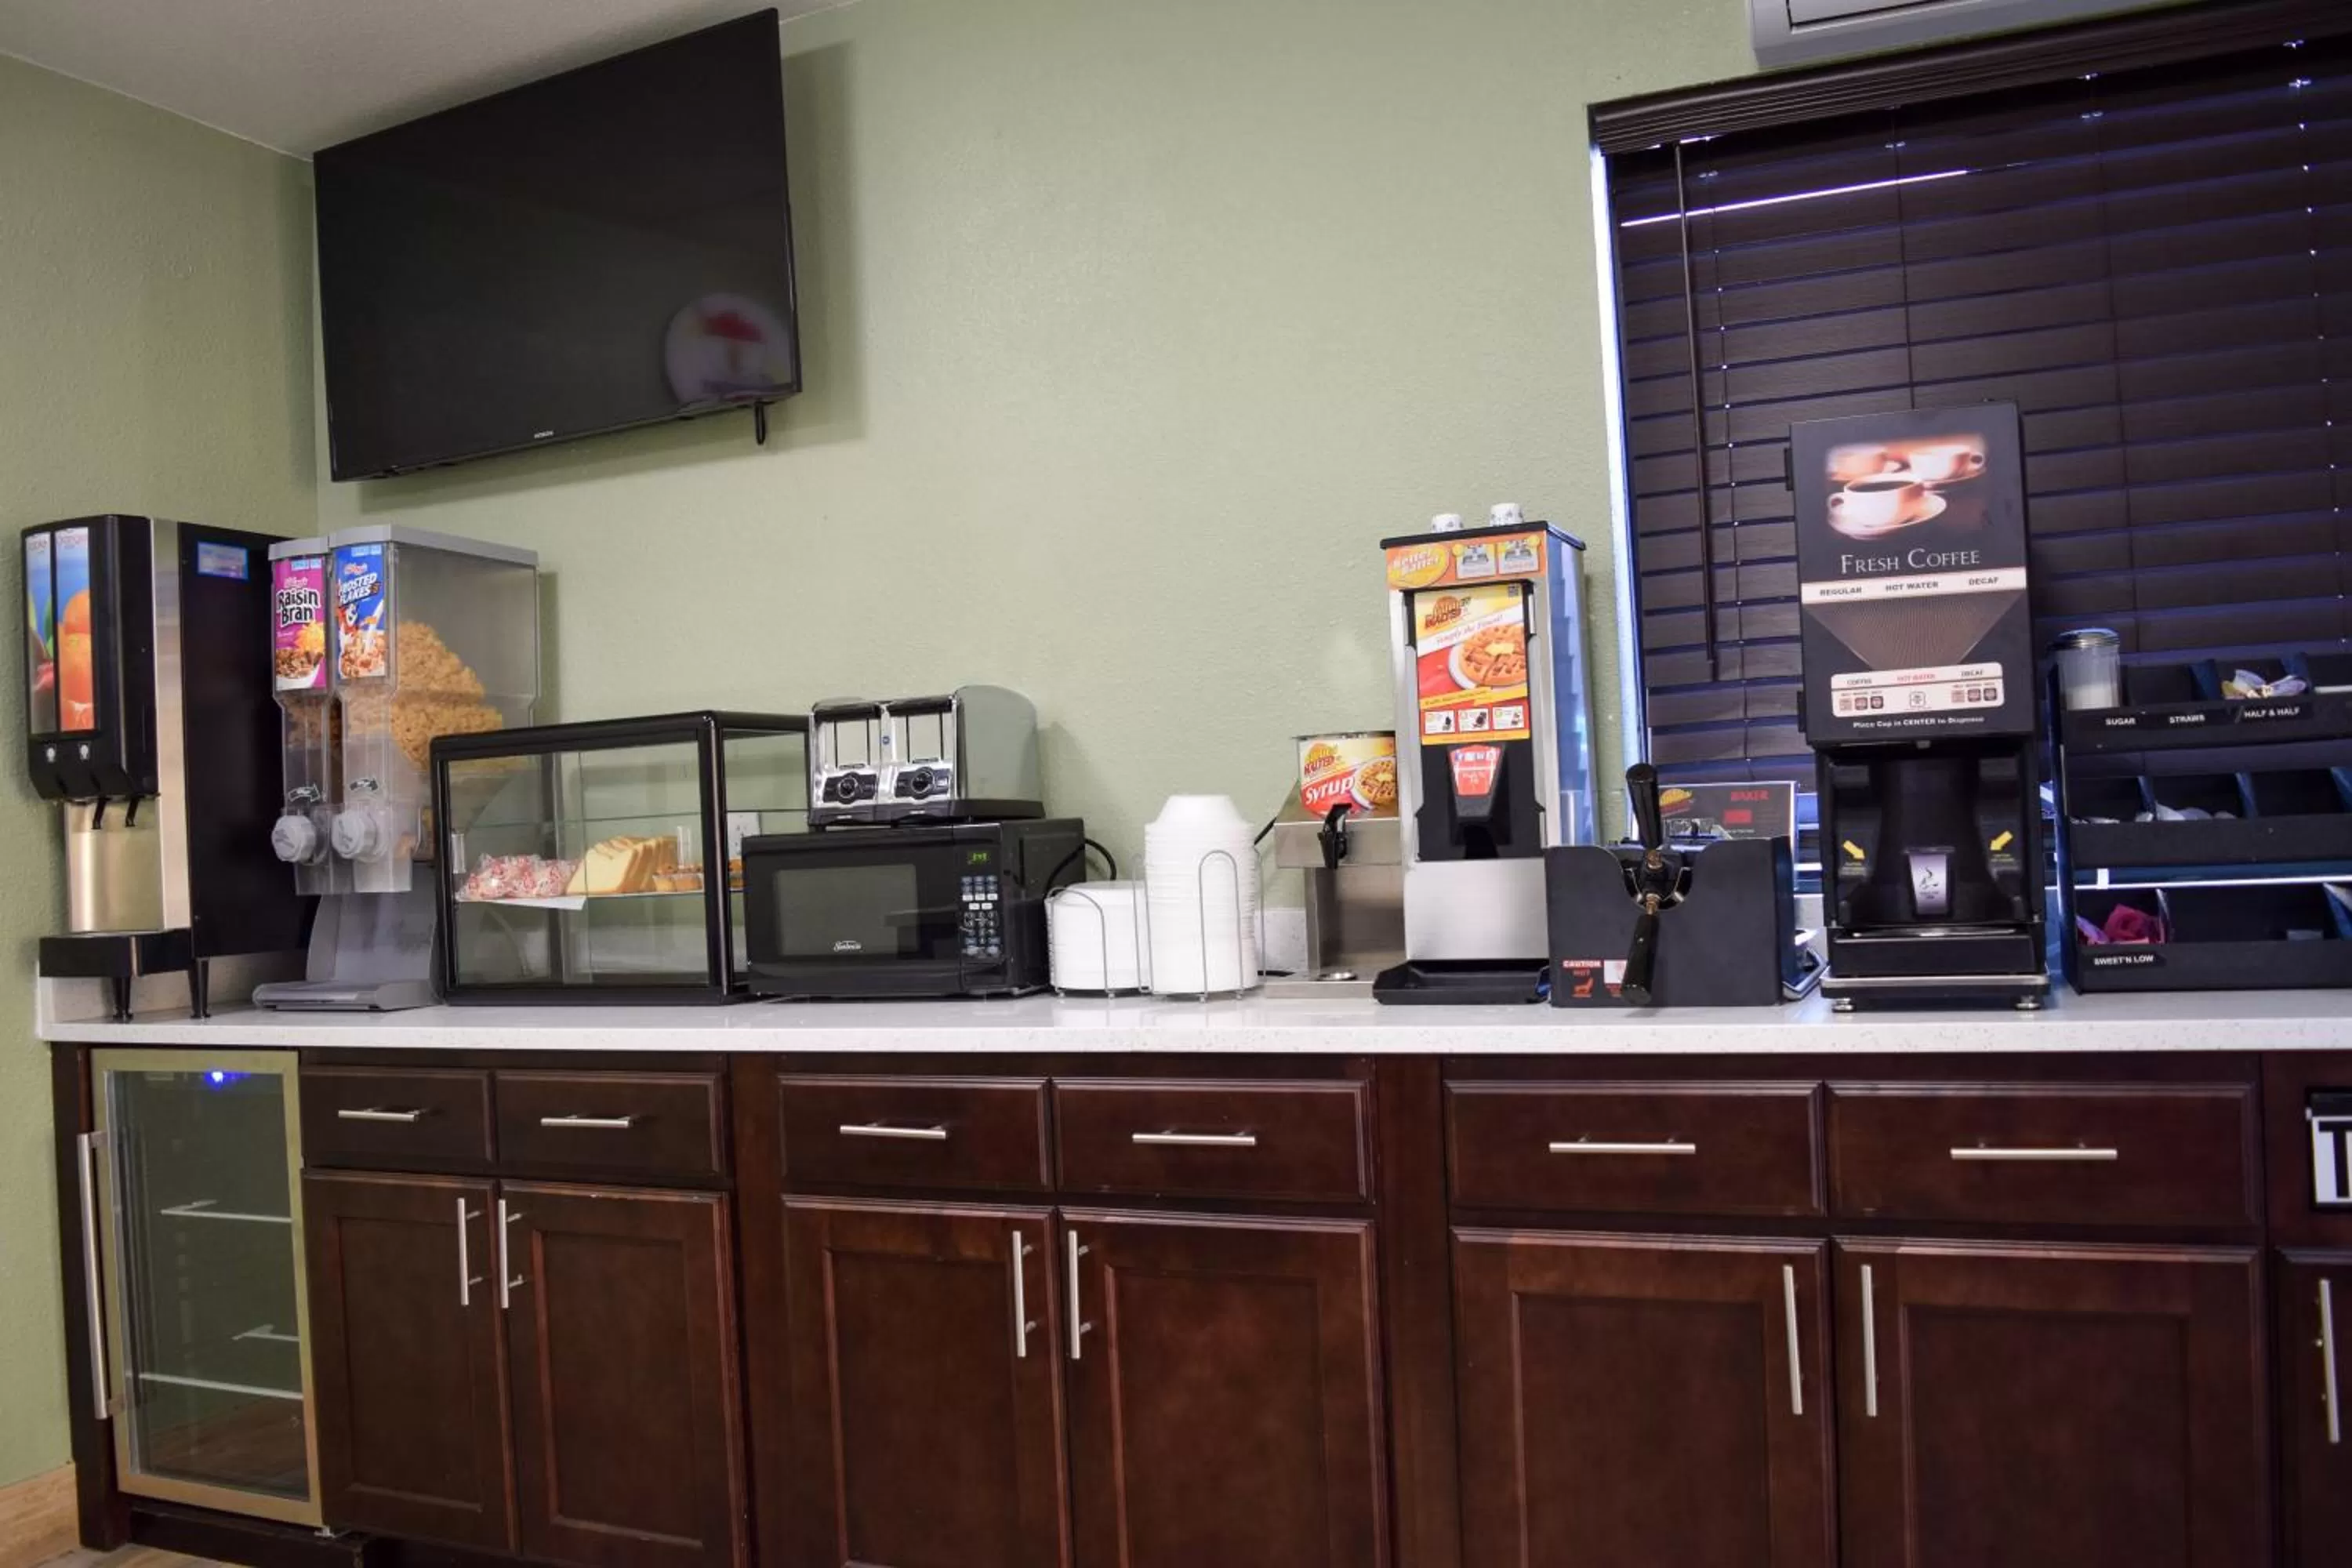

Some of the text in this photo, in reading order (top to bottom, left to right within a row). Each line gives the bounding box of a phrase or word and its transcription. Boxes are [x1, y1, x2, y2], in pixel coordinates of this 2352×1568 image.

[1840, 548, 1981, 575] FRESH COFFEE
[1968, 576, 2000, 586] DECAF
[1819, 586, 1863, 597] REGULAR
[1885, 581, 1939, 593] HOT WATER
[276, 588, 321, 611] Raisin
[281, 604, 314, 626] Bran
[2244, 709, 2267, 718] HALF
[2277, 706, 2300, 717] HALF
[1903, 717, 1936, 727] CENTER
[2105, 717, 2136, 726] SUGAR
[2169, 714, 2205, 724] STRAWS
[1563, 960, 1602, 968] CAUTION
[2133, 954, 2154, 964] LOW
